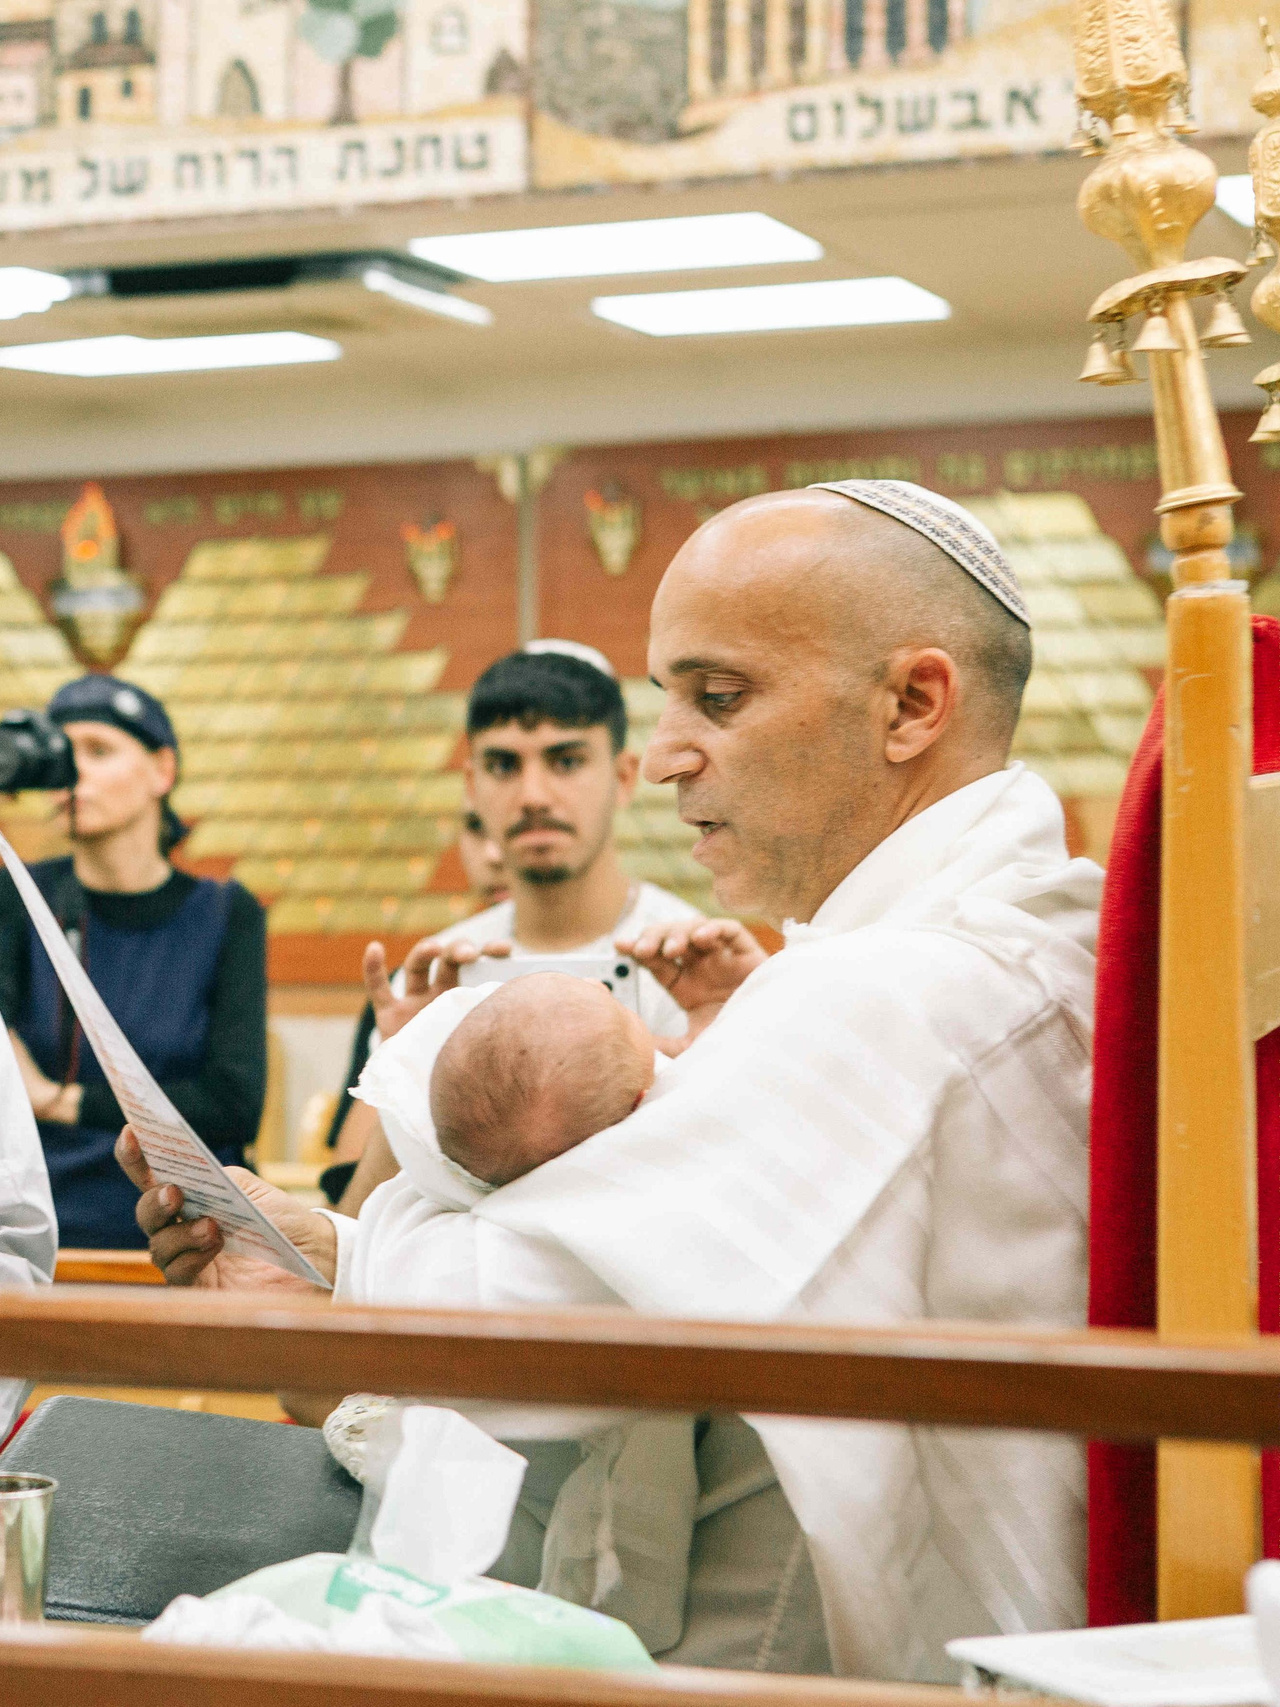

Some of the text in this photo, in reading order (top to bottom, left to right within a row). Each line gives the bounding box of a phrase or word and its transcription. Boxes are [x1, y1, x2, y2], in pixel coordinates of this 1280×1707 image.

[786, 79, 1046, 144] אבשלום
[77, 152, 151, 201] של
[172, 145, 299, 192] הרוח
[336, 131, 492, 182] טחנת
